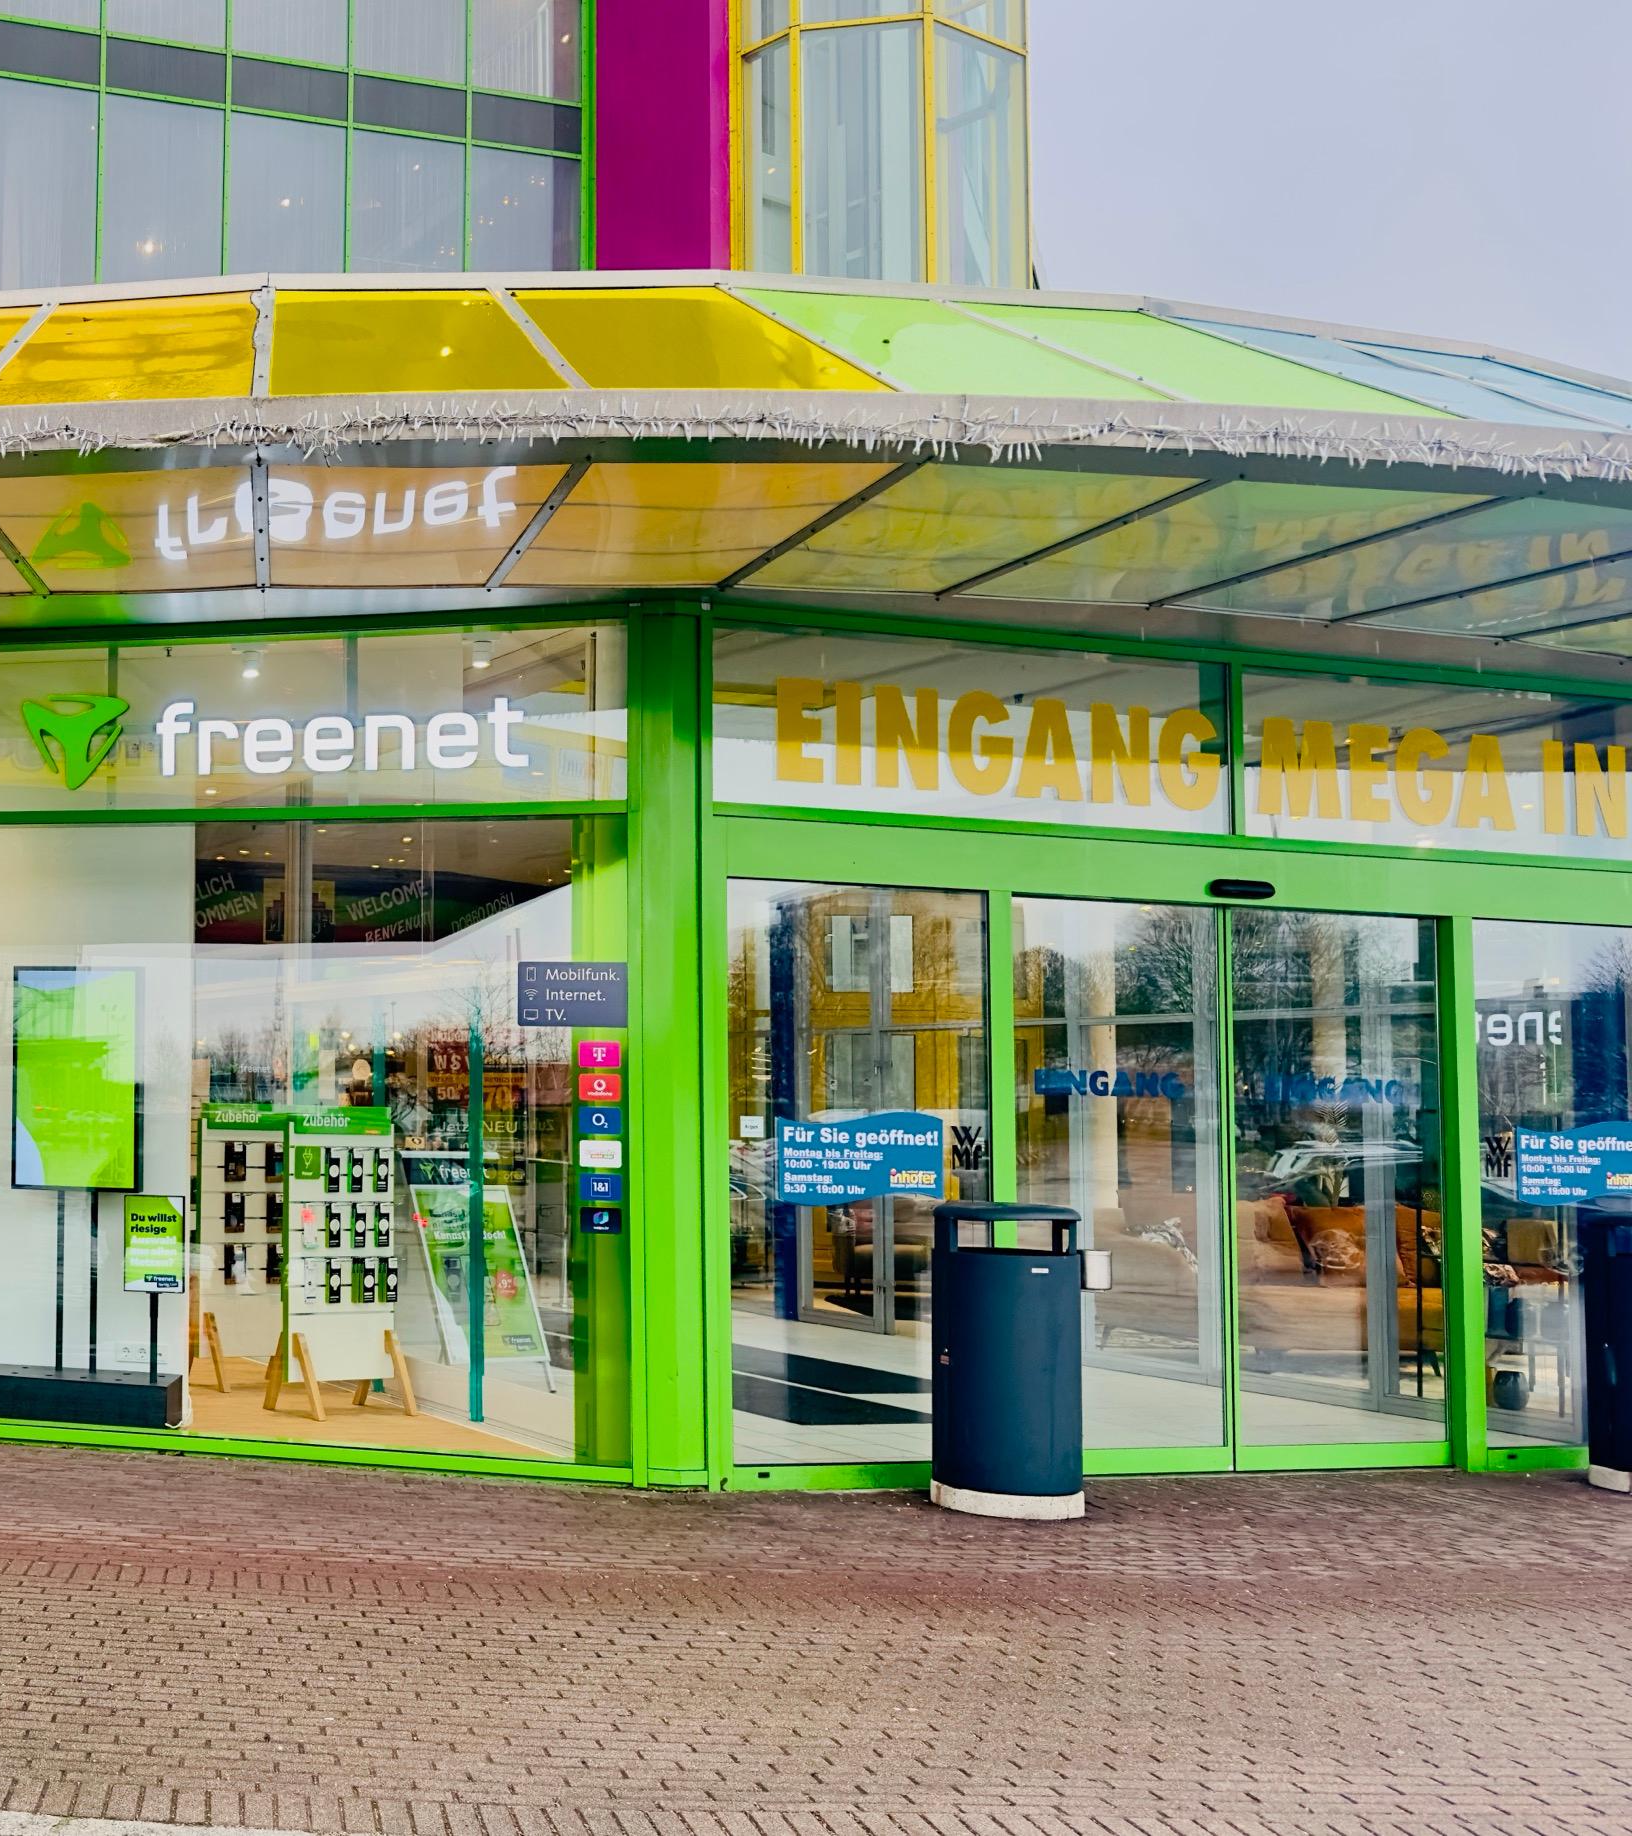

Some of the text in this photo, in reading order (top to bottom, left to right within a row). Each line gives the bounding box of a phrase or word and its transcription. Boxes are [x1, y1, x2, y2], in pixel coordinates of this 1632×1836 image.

[156, 695, 530, 777] freenet
[776, 676, 1222, 812] EINGANG
[1256, 716, 1517, 833] MEGA
[346, 879, 429, 922] WELCOME
[545, 967, 620, 981] Mobilfunk.
[546, 988, 606, 1001] Internet.
[545, 1008, 567, 1021] TV.
[215, 1110, 262, 1123] Zubehör
[302, 1114, 351, 1127] Zubehör
[439, 1121, 470, 1133] Jetz
[482, 1121, 518, 1134] NEU
[783, 1126, 939, 1147] Für Sie geöffnet!
[1520, 1135, 1546, 1149] Für
[1550, 1135, 1574, 1150] Sie
[783, 1147, 884, 1160] Montag bis Freitag:
[1521, 1154, 1552, 1165] Montag
[1569, 1155, 1601, 1165] Freitag:
[783, 1159, 813, 1169] 10:00
[822, 1160, 851, 1169] 19:00
[852, 1161, 871, 1170] Uhr
[1521, 1165, 1545, 1173] 10:00
[1554, 1165, 1575, 1173] 19:00
[1577, 1166, 1592, 1174] Uhr
[439, 1164, 490, 1180] freet
[783, 1172, 833, 1183] Samstag:
[592, 1182, 609, 1192] 1&1
[1521, 1176, 1562, 1187] Samstag:
[783, 1184, 807, 1193] 9:30
[816, 1185, 845, 1194] 19:00
[847, 1185, 866, 1195] Uhr
[1522, 1187, 1541, 1195] 9:30
[1550, 1187, 1571, 1195] 19:00
[1572, 1188, 1588, 1196] Uhr
[131, 1213, 177, 1223] Du willst
[130, 1224, 167, 1235] riesige
